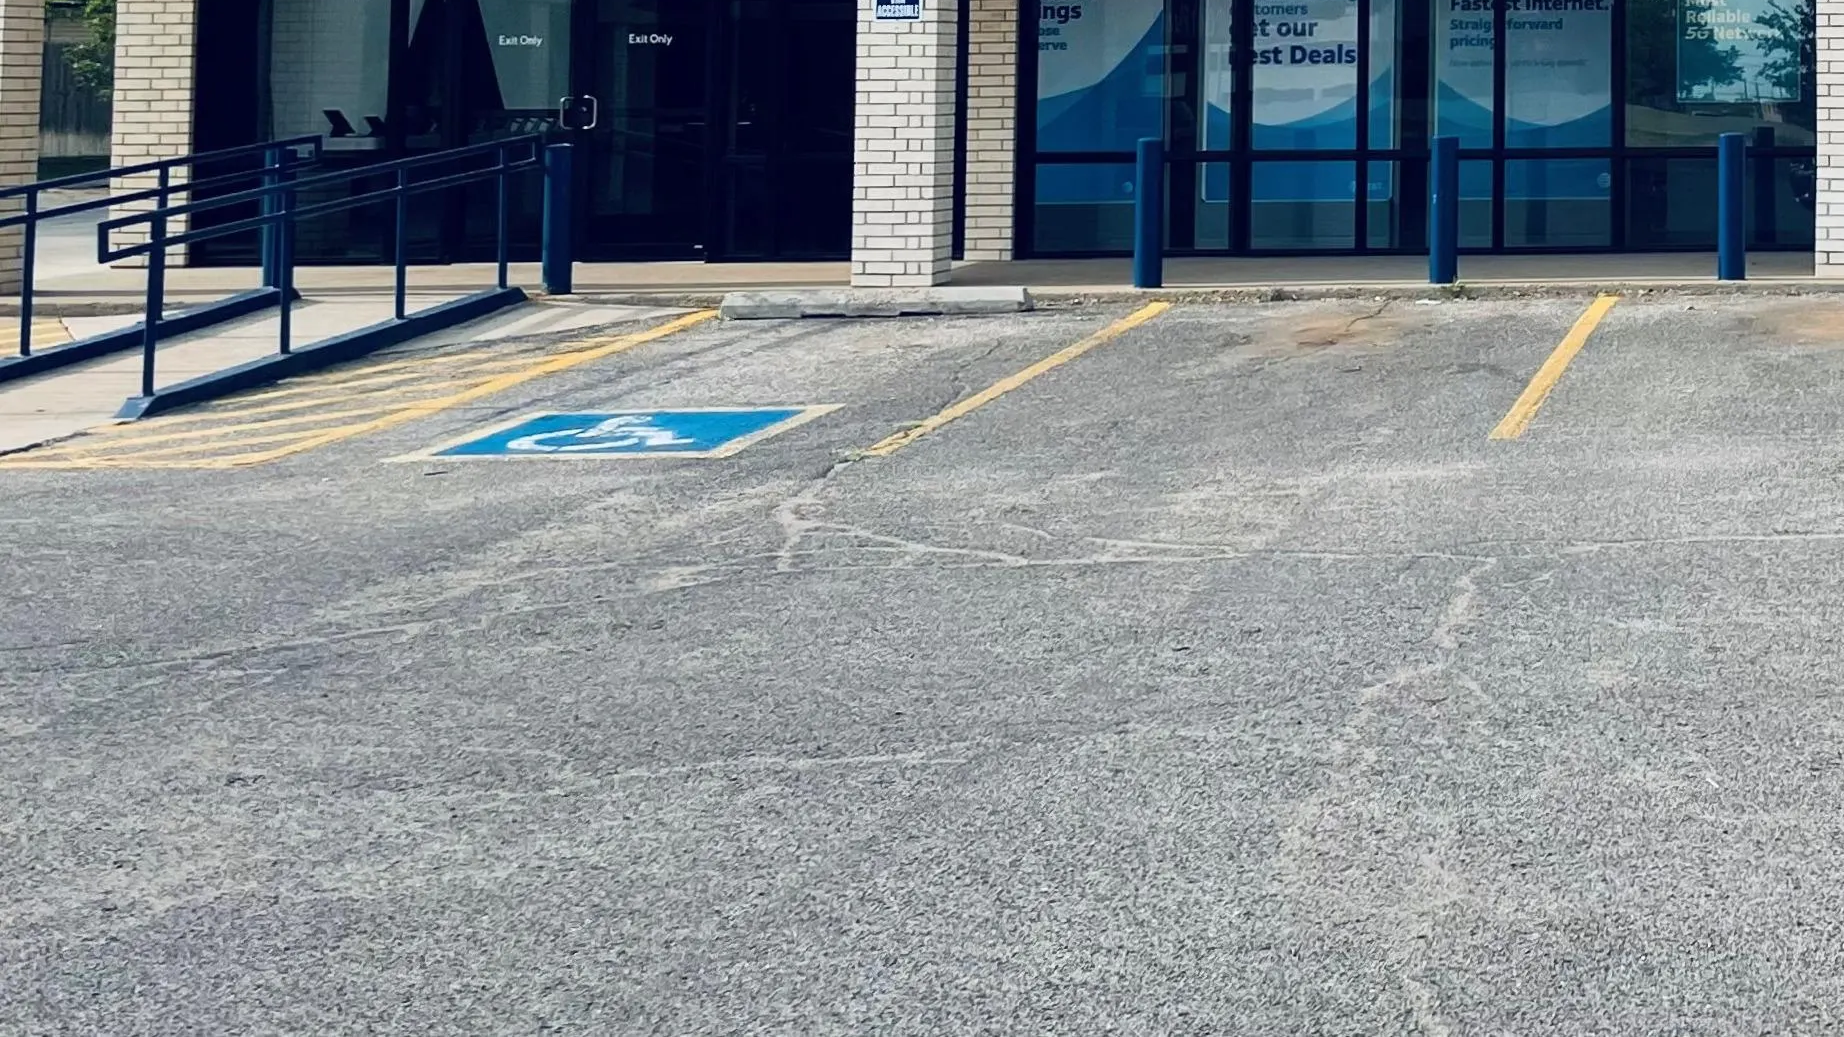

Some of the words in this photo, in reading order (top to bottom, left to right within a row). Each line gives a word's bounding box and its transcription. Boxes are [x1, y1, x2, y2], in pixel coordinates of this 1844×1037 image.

[877, 4, 919, 17] ACCESSIBLE
[1277, 21, 1318, 37] our
[499, 35, 519, 46] Exit
[520, 35, 543, 47] Only
[628, 34, 648, 44] Exit
[650, 34, 673, 46] Only
[1290, 44, 1356, 64] Deals
